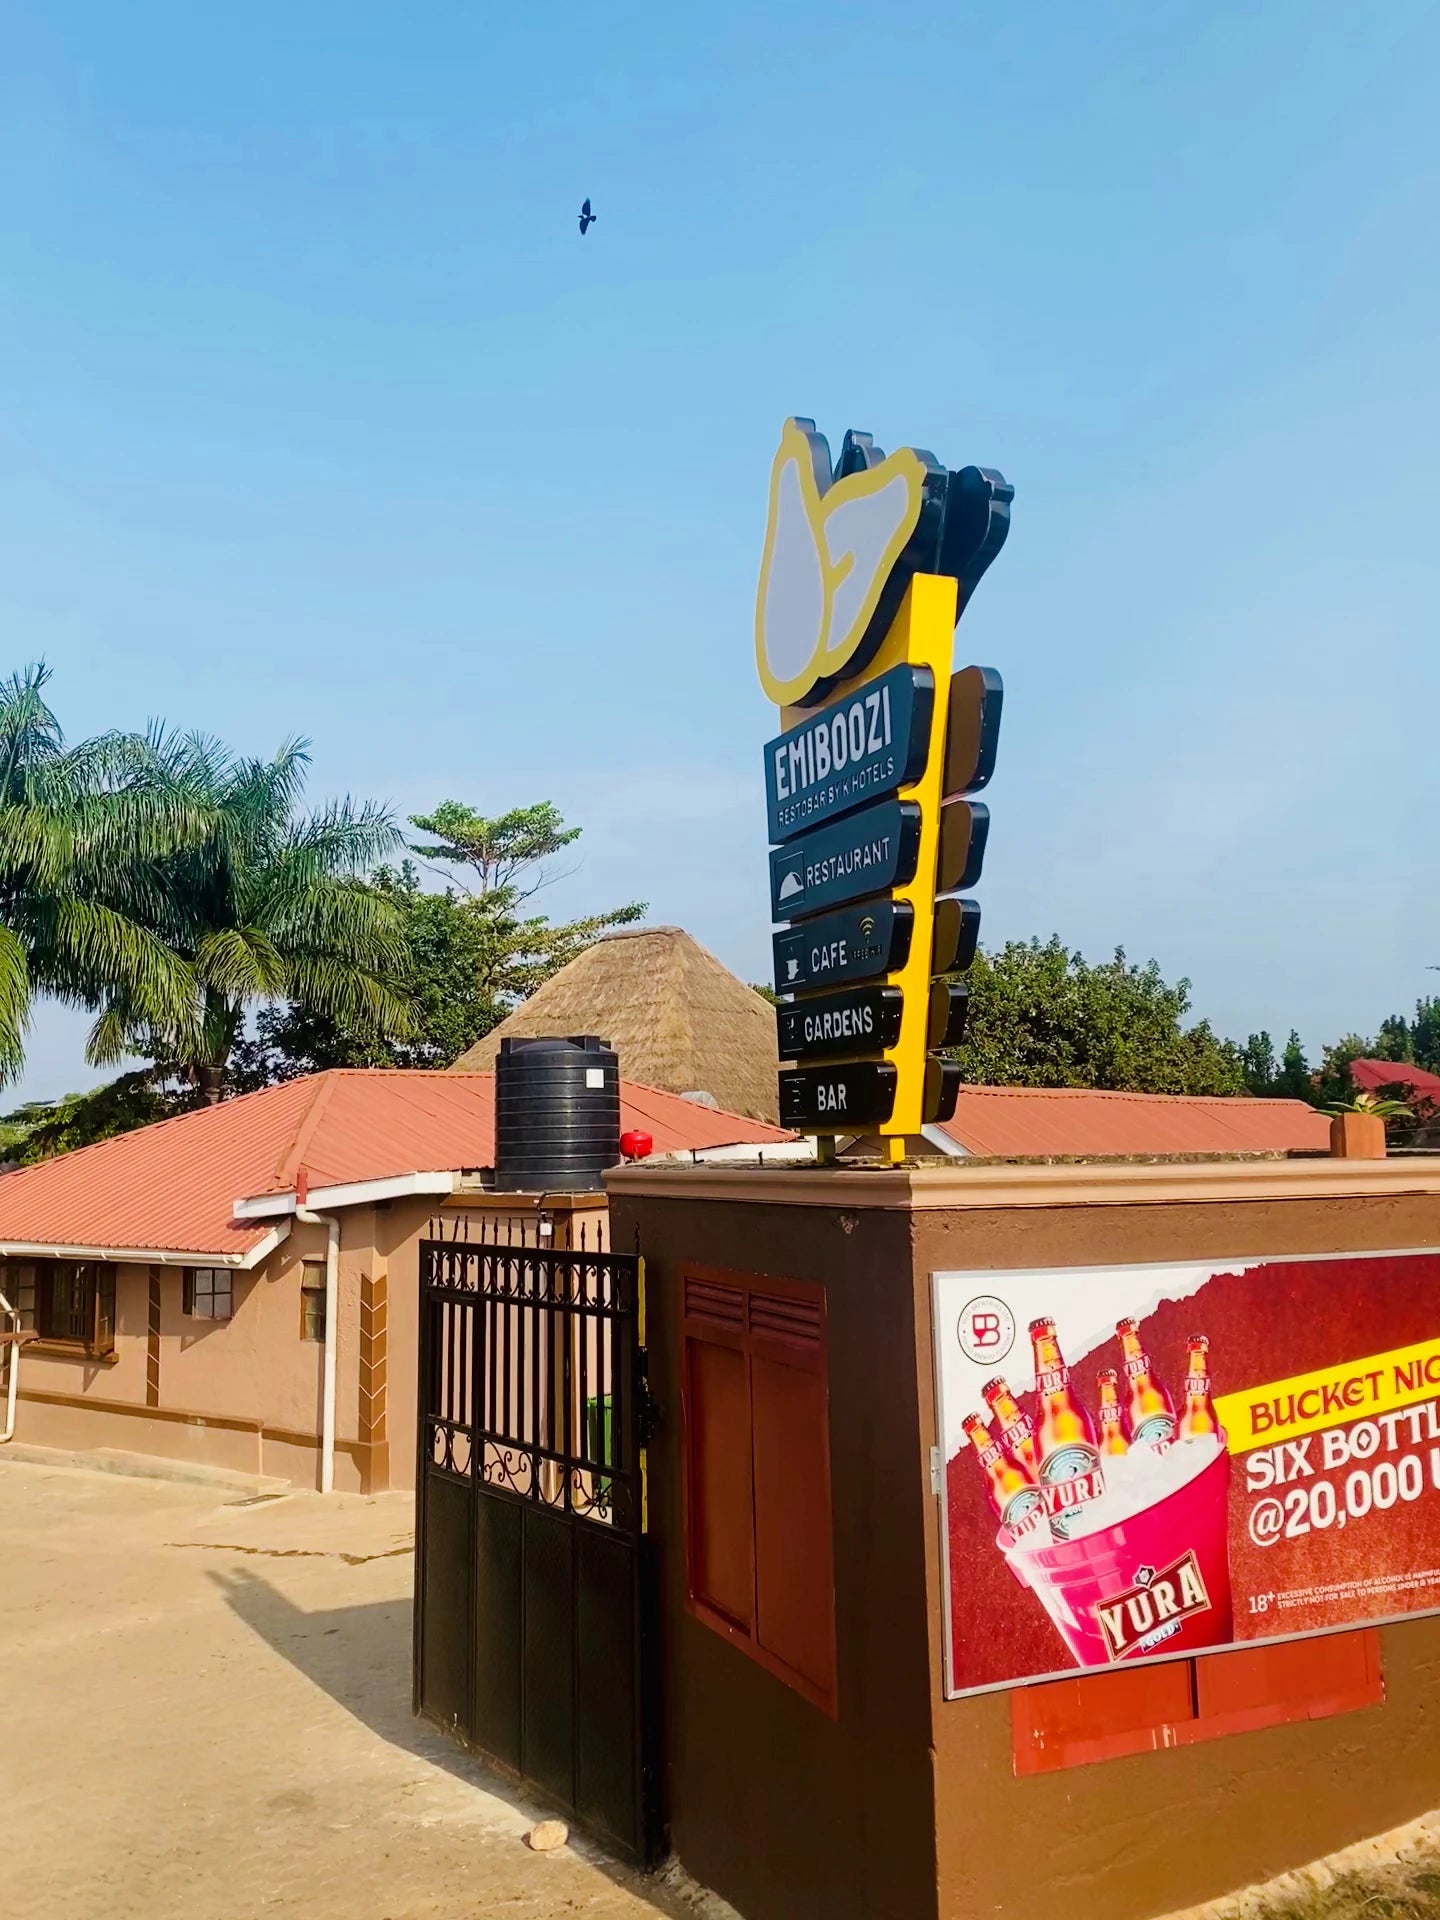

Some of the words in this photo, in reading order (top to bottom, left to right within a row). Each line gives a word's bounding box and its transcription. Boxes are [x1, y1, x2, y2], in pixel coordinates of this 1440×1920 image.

[774, 686, 892, 801] EMIBOOZI
[778, 791, 826, 828] RESTOBAR
[828, 783, 841, 804] BY
[843, 778, 849, 797] K
[852, 757, 894, 792] HOTELS
[806, 837, 890, 888] RESTAURANT
[811, 940, 847, 973] CAFE
[804, 1005, 874, 1042] GARDENS
[817, 1083, 848, 1111] BAR
[1250, 1370, 1384, 1435] BUCKET
[1246, 1437, 1315, 1493] SIX
[1322, 1400, 1440, 1470] BOTTL
[1042, 1469, 1105, 1514] YURA
[1249, 1454, 1424, 1547] @20,000
[1100, 1561, 1206, 1649] YURA
[1248, 1590, 1275, 1614] 18+
[1277, 1587, 1313, 1600] EXCESSIVE
[1314, 1580, 1362, 1595] CONSUMPTION
[1363, 1578, 1373, 1588] OF
[1374, 1574, 1403, 1585] ALCOHOL
[1278, 1597, 1309, 1609] STRICTLY
[1310, 1594, 1324, 1604] NOT
[1325, 1592, 1338, 1601] FOR
[1340, 1589, 1355, 1599] SALE
[1357, 1587, 1366, 1597] TO
[1367, 1583, 1396, 1594] PERSONS
[1397, 1579, 1419, 1591] UNDER
